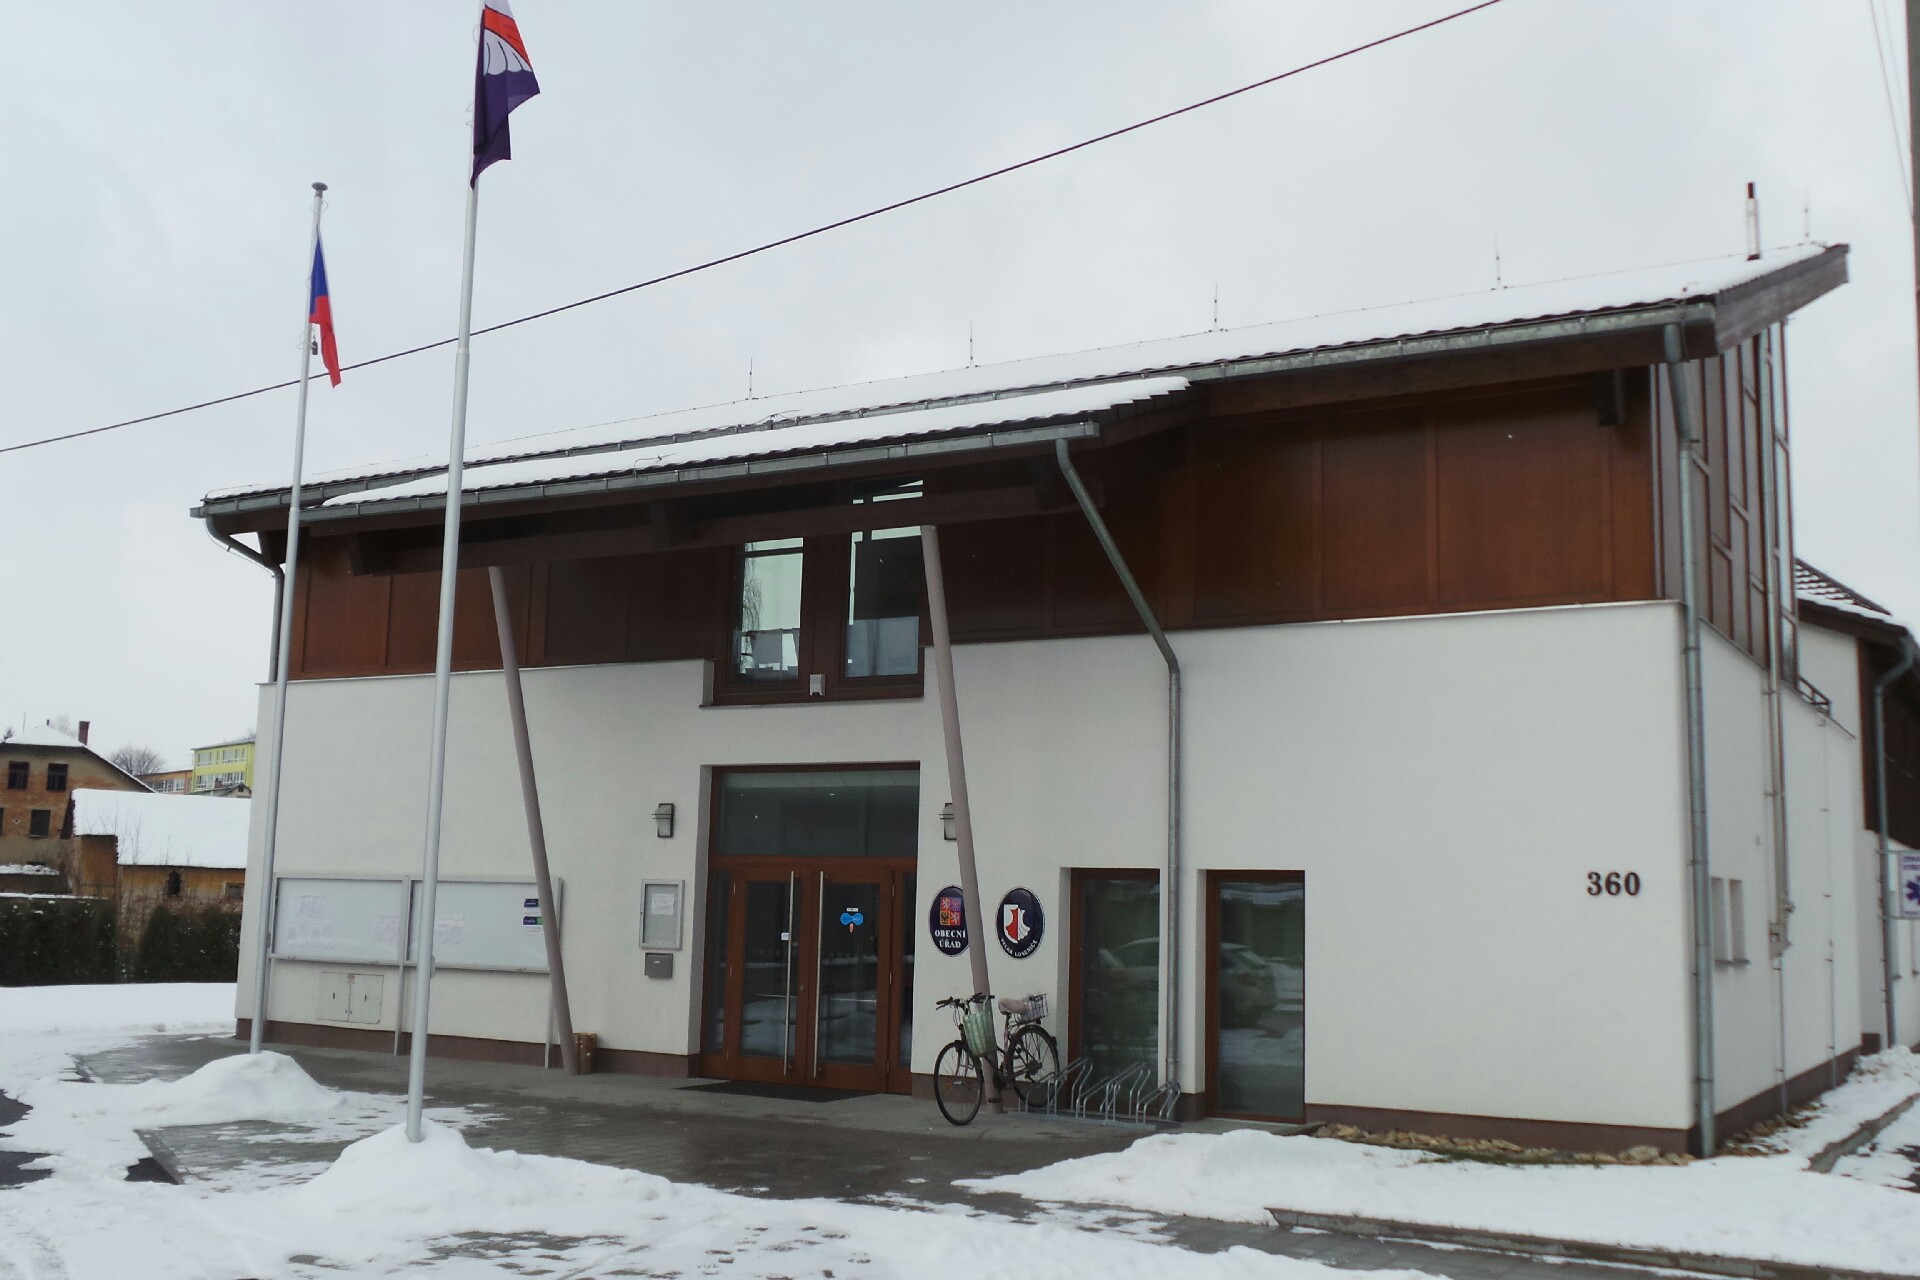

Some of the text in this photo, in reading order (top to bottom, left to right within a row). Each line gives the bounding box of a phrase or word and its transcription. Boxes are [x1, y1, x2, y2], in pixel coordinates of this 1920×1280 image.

[1587, 871, 1641, 896] 360
[934, 929, 966, 939] OBECNÍ
[939, 938, 961, 949] ÚŘAD
